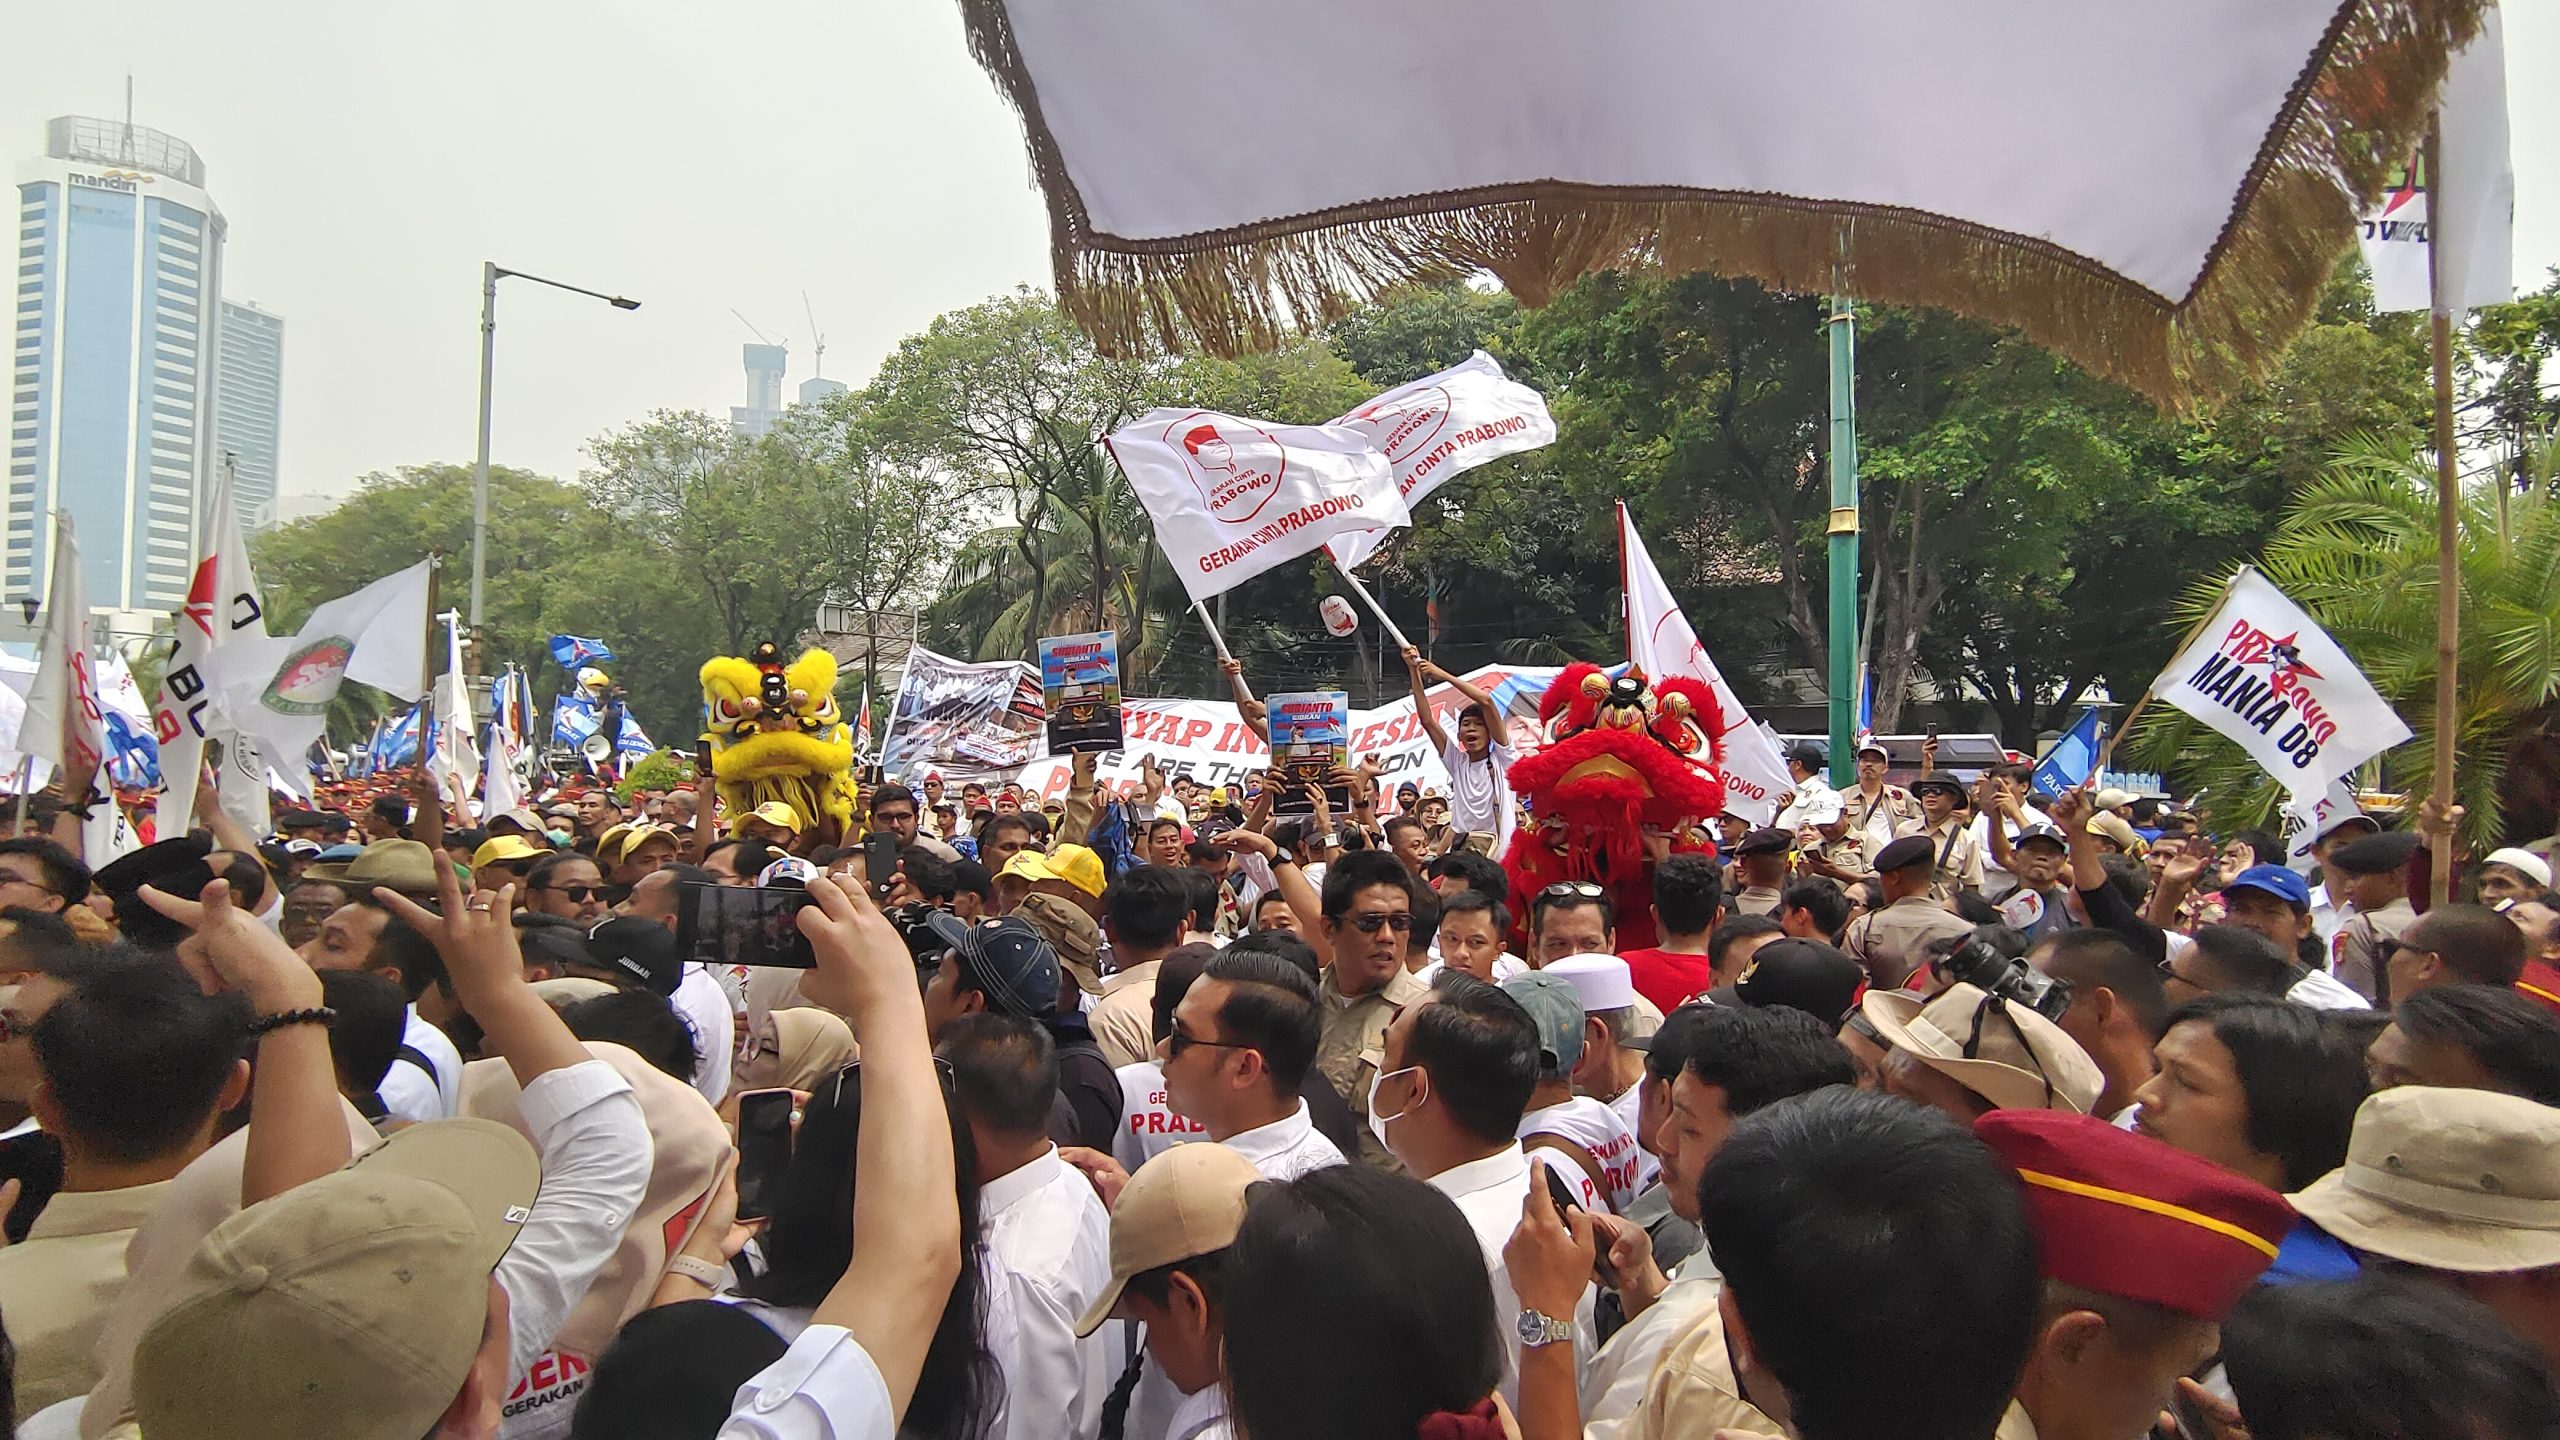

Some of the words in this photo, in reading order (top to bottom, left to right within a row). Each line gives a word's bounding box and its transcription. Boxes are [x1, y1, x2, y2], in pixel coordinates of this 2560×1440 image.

[68, 173, 137, 192] mandiri
[1384, 406, 1440, 457] PRABOWO
[1415, 440, 1458, 477] CINTA
[1455, 415, 1528, 448] PRABOWO
[1234, 468, 1256, 482] CINTA
[1199, 537, 1259, 573] GERAKAN
[1251, 523, 1285, 545] CINTA
[1277, 493, 1364, 534] PRABOWO
[2186, 651, 2291, 736] MANIA
[2277, 722, 2319, 769] 08
[1130, 1112, 1206, 1136] PRAB
[502, 1379, 584, 1418] GERAKAN
